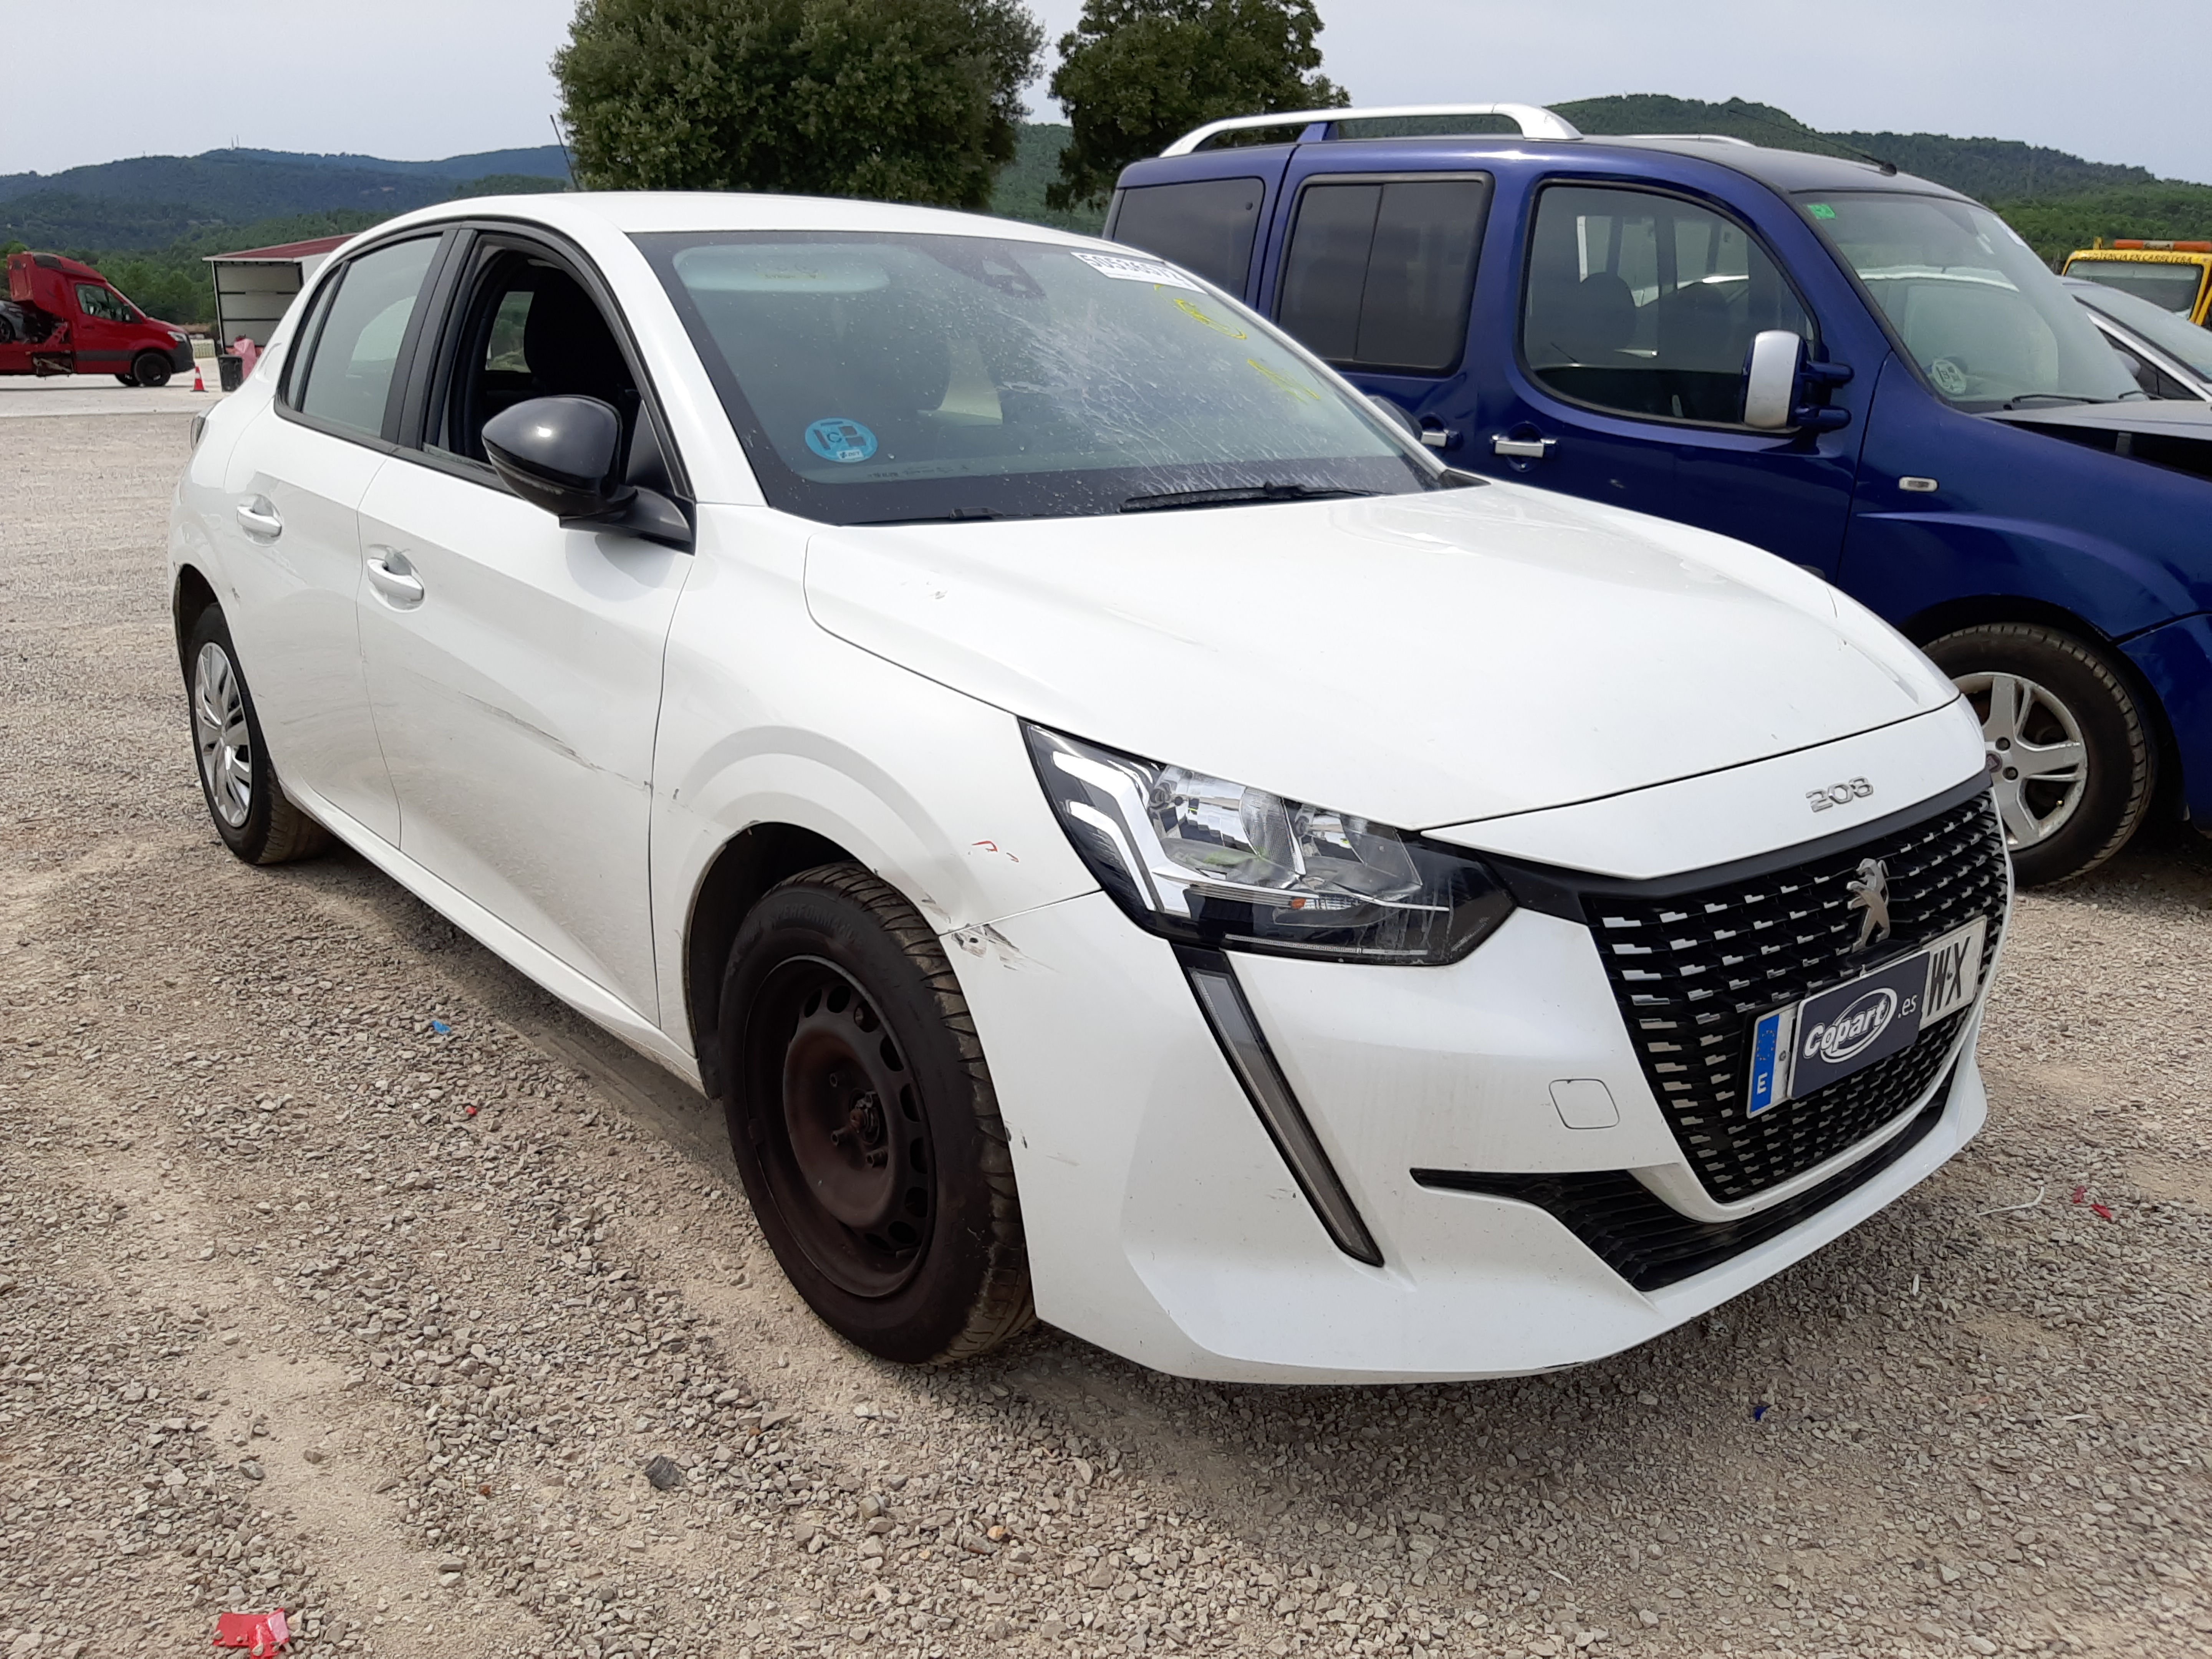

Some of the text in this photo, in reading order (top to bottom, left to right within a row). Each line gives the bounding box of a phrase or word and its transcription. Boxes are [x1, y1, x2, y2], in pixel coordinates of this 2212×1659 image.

[826, 432, 843, 443] C
[1805, 775, 1874, 813] 208
[1803, 997, 1887, 1059] Copart
[1757, 1072, 1768, 1095] E
